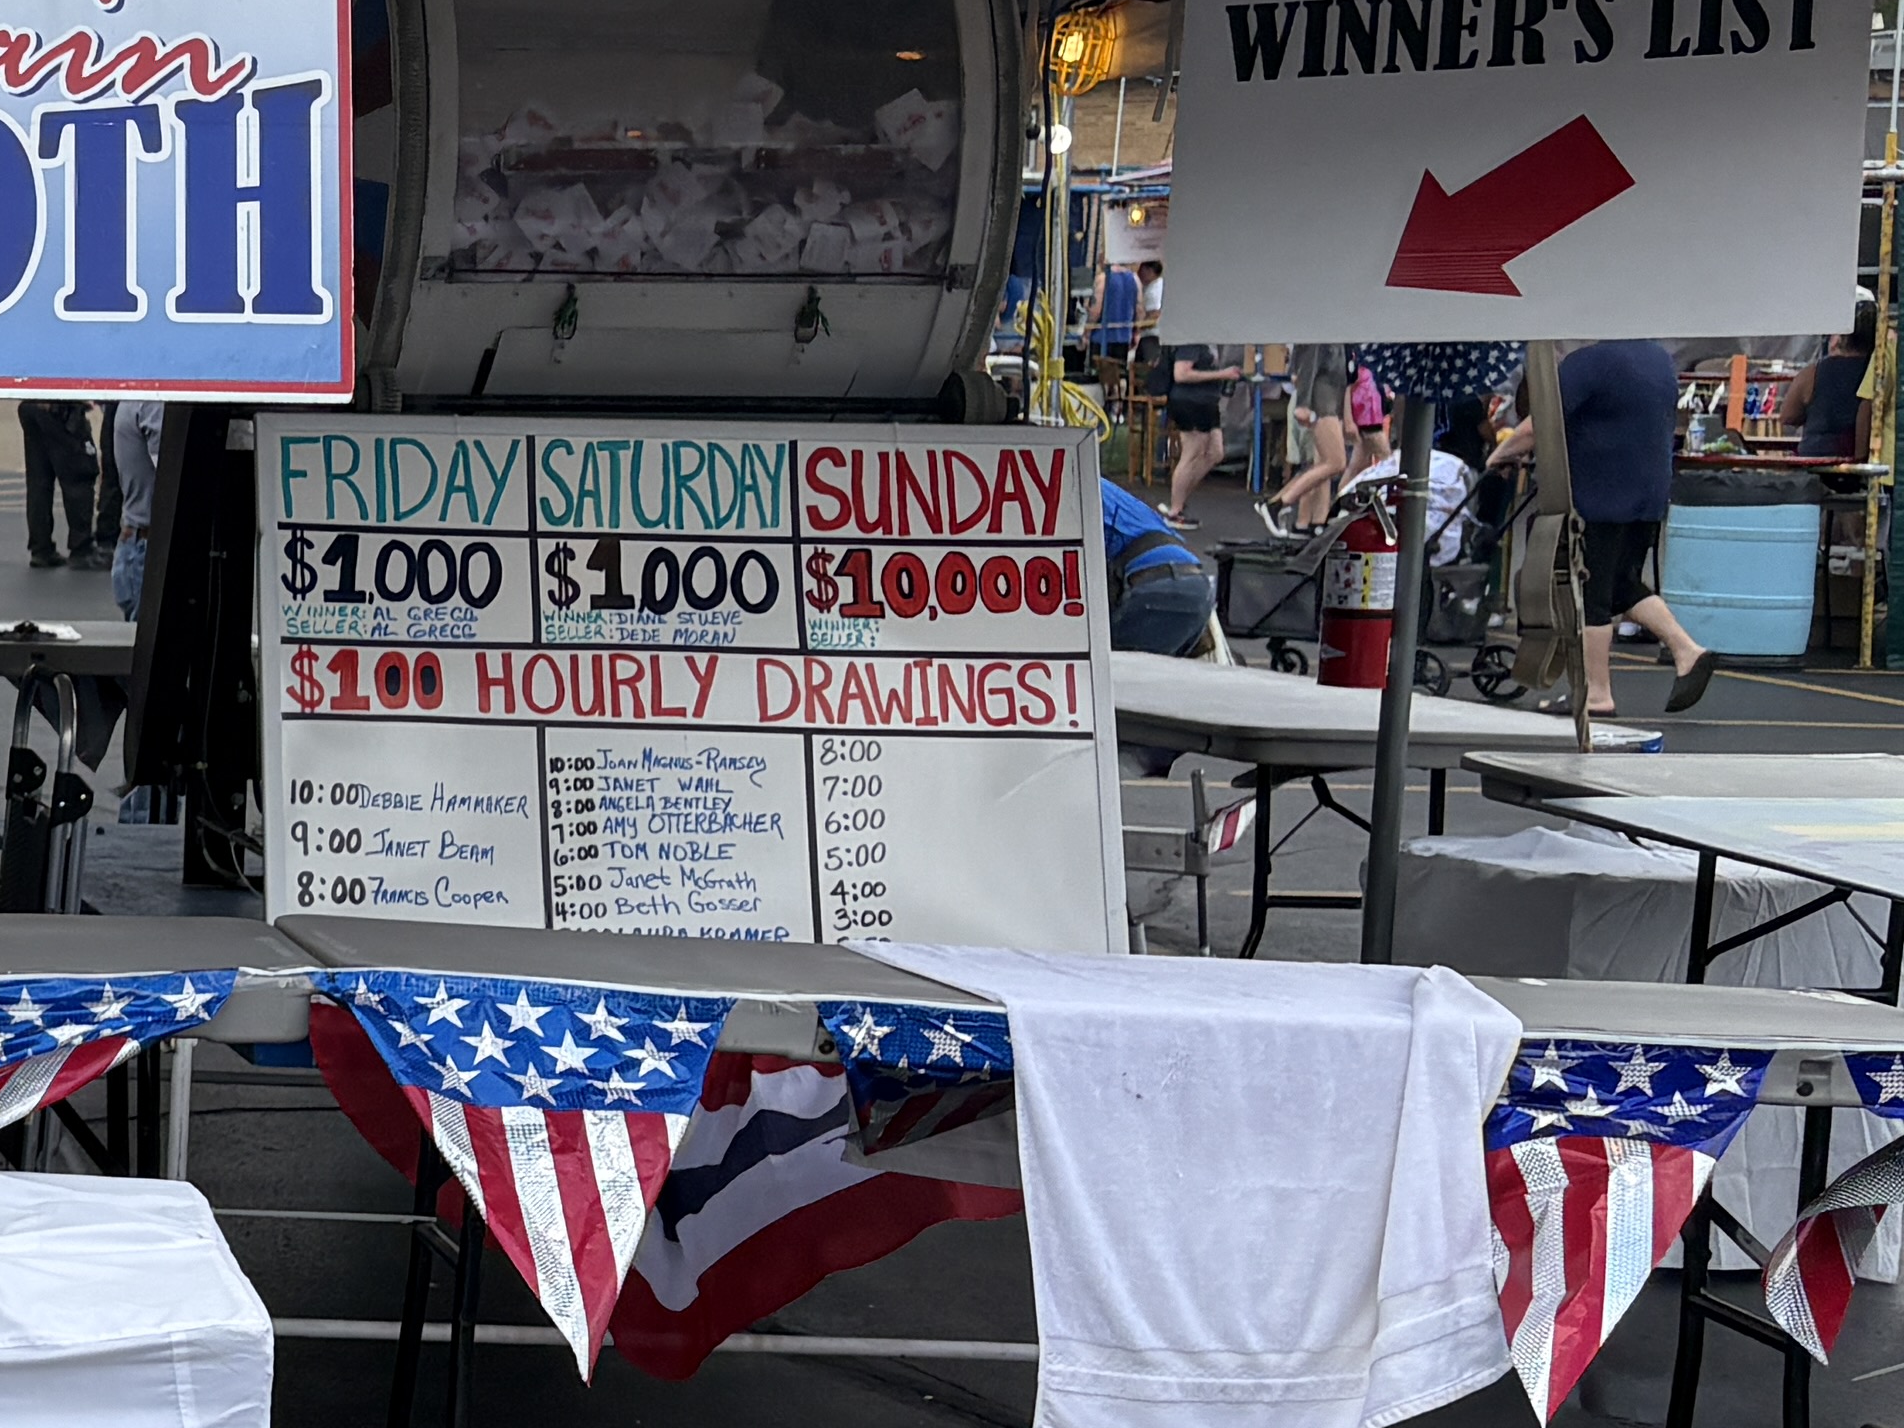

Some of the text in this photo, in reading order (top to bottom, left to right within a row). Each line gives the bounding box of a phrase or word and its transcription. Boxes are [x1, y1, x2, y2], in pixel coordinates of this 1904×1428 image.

[280, 435, 1065, 536] FRIDAY SATURDAY SUNDAY
[280, 529, 1084, 621] $1,000 $1,000 $10,000!
[282, 604, 366, 620] WINNER:
[373, 608, 398, 622] AL
[542, 610, 613, 625] WINNER:
[808, 618, 880, 632] WINNER:
[286, 618, 367, 637] SELLER:
[371, 623, 400, 638] AL
[545, 624, 736, 646] SELLER: DEDE MORAN
[809, 632, 876, 649] SELLER:
[286, 643, 1080, 728] $100 HOURLY DRAWINGS!
[549, 756, 595, 773] 10:00
[820, 738, 882, 765] 8:00
[290, 779, 359, 805] 10:00
[358, 784, 423, 811] DEBBIE
[549, 776, 733, 795] 9:00 JANET WAHL
[823, 774, 882, 801] 7:00
[551, 796, 732, 819] 8:00 ANGELA BENTLEY
[825, 808, 886, 834] 6:00
[291, 820, 362, 856] 9:00
[551, 812, 784, 844] 7:00 AMY OTTERBACHER
[553, 841, 736, 866] 6:00 TOM NOBLE
[824, 842, 886, 871] 5:00
[297, 870, 366, 907] 8:00
[553, 865, 757, 897] 5:00 Janet McGrath
[830, 879, 886, 906] 4:00
[555, 891, 762, 922] 4:00 Beth Gosser
[833, 908, 892, 931] 3:00
